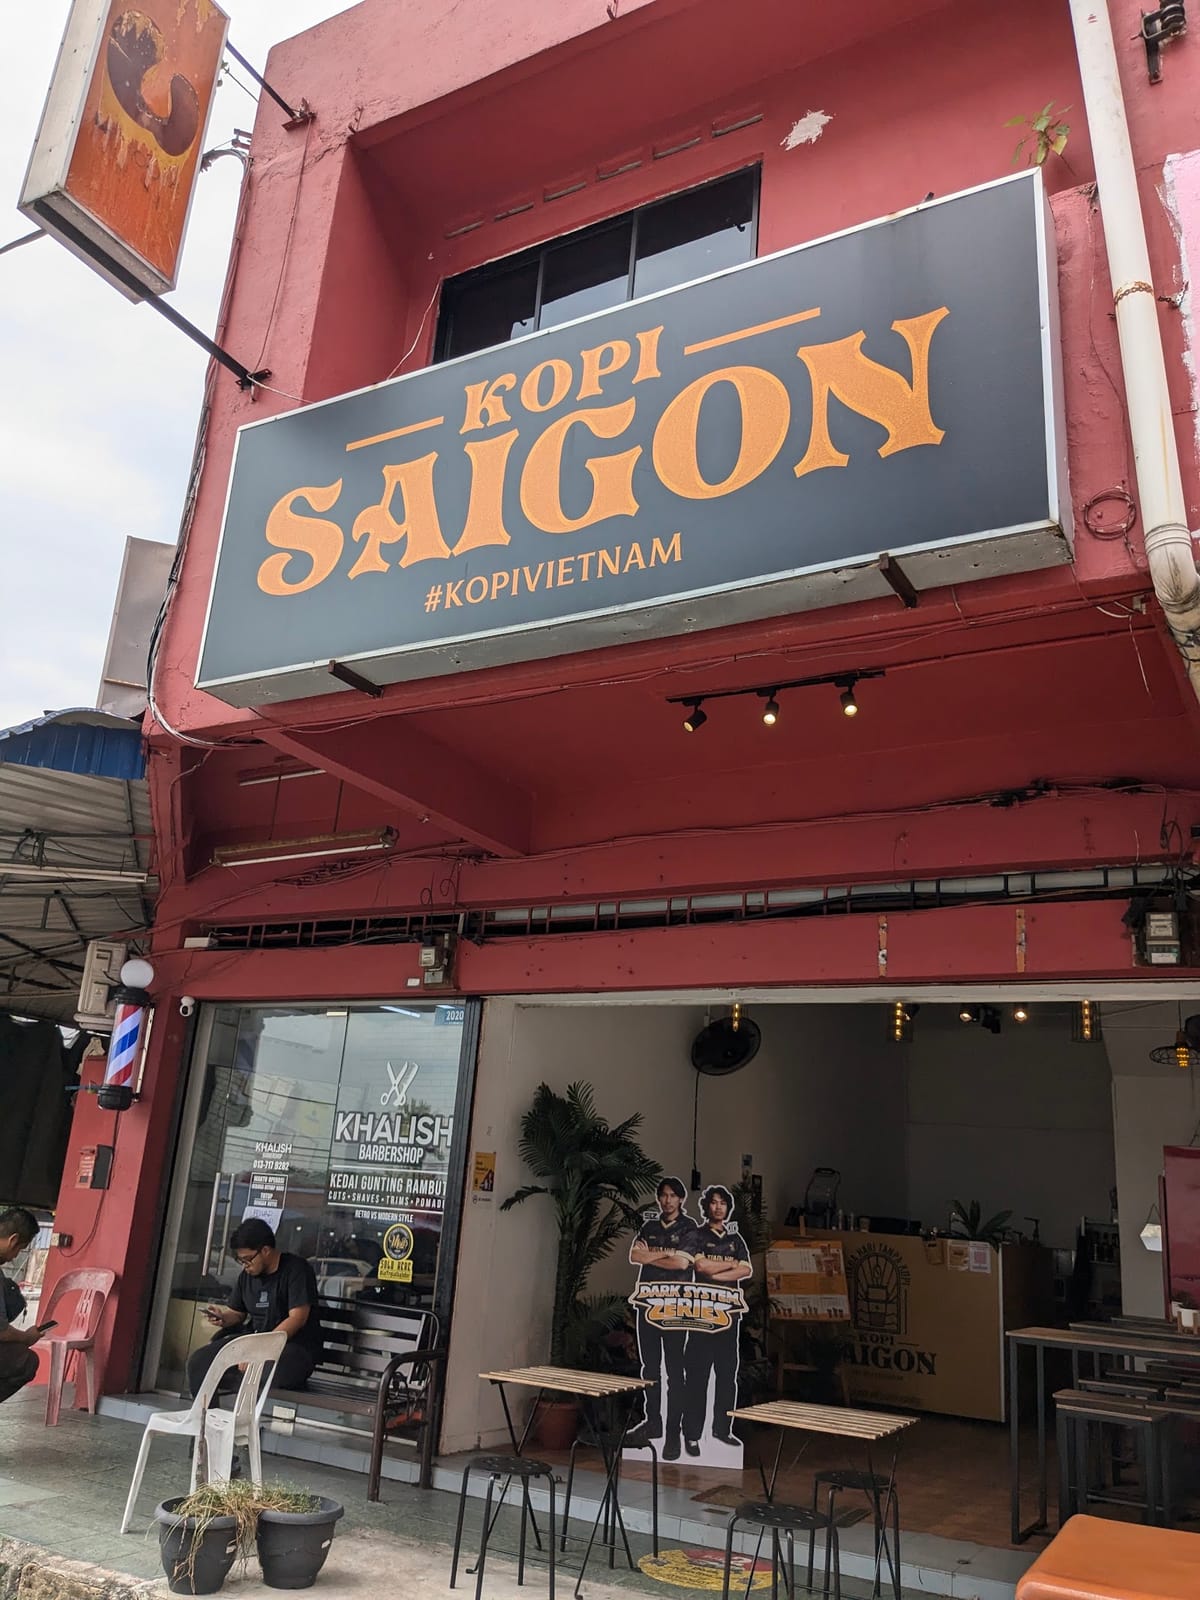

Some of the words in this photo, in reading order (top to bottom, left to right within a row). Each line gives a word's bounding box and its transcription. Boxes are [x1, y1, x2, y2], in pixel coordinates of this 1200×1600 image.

[459, 325, 665, 436] KOPI
[256, 306, 951, 597] SAIGON
[423, 531, 683, 614] #KOPIVIETNAM
[446, 1010, 465, 1021] 2020
[335, 1112, 454, 1147] KHALISH
[255, 1142, 293, 1153] KHALISH
[358, 1144, 424, 1164] BARBERSHOP
[329, 1173, 359, 1189] KEDAI
[360, 1175, 403, 1193] GUNTING
[405, 1179, 448, 1196] RAMBUT
[328, 1190, 346, 1201] CUTS
[351, 1192, 380, 1204] SHAVES
[386, 1195, 409, 1207] TRIMS
[415, 1197, 445, 1209] POMAD
[355, 1209, 370, 1219] RETRO
[370, 1211, 378, 1220] VS
[399, 1214, 414, 1223] STYLE
[637, 1284, 681, 1299] DARK
[682, 1286, 741, 1306] SYSTEM
[646, 1297, 733, 1326] ZERIES
[858, 1333, 895, 1346] KOPI
[840, 1341, 937, 1376] AIGON
